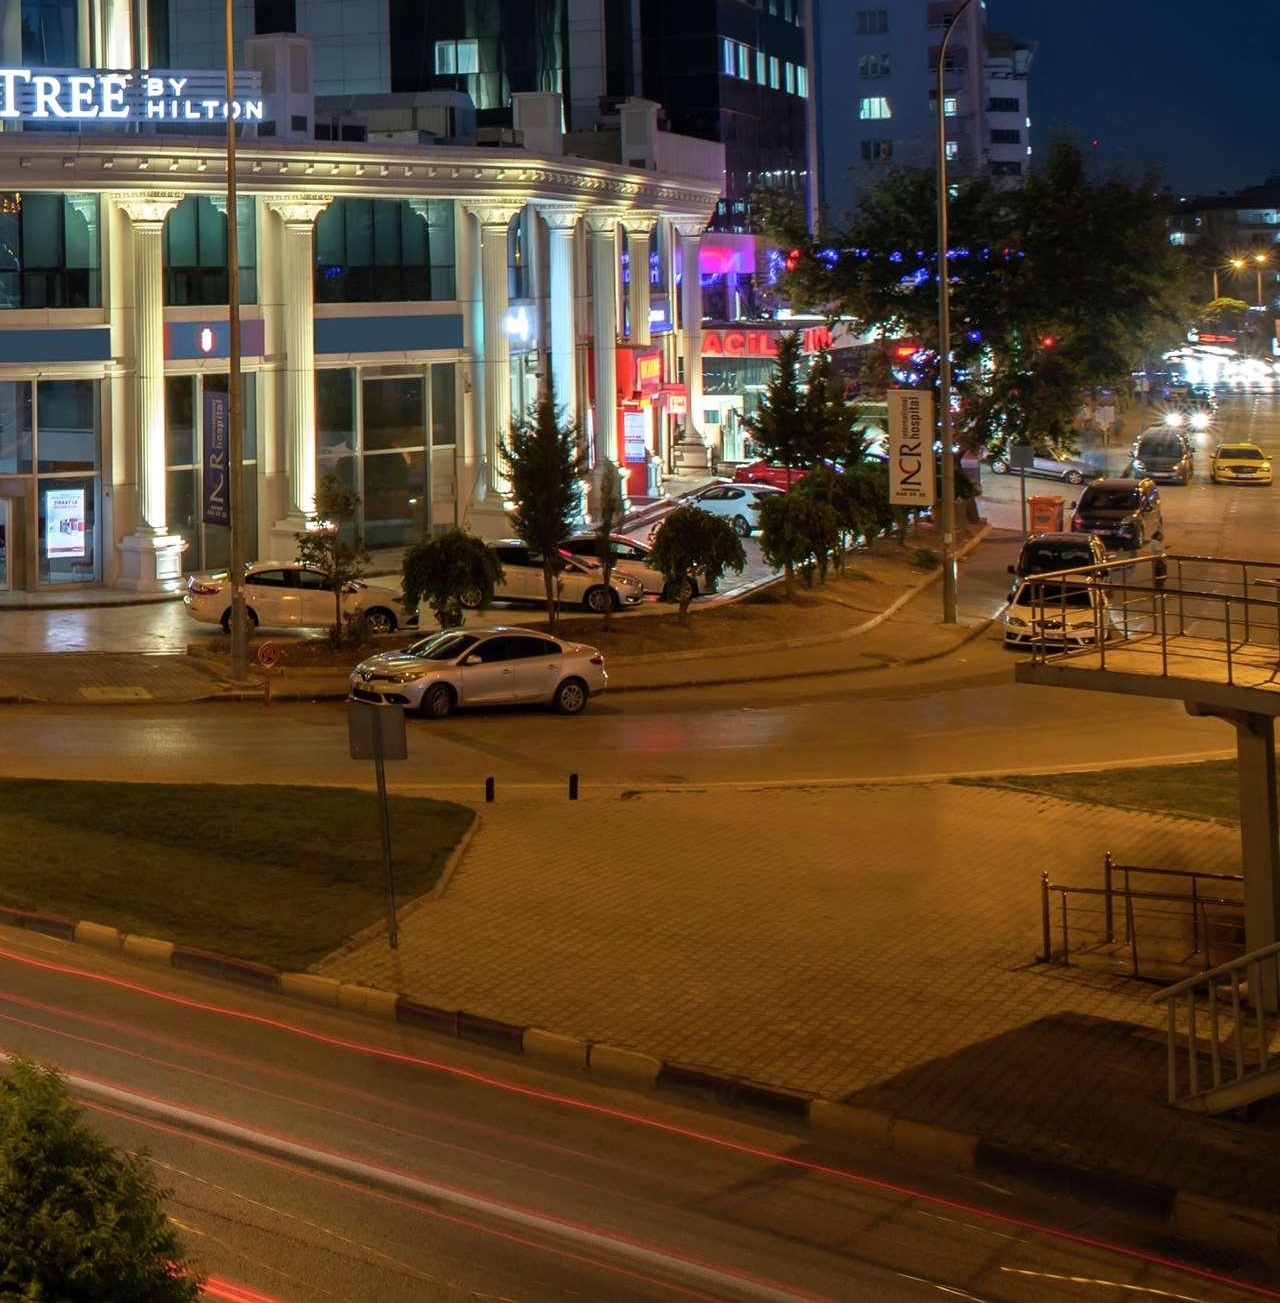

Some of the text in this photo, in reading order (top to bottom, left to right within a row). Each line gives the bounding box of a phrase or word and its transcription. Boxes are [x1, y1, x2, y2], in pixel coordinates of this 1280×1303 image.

[147, 78, 188, 96] BY
[147, 100, 263, 119] HILTON
[215, 399, 225, 449] hospital
[909, 397, 922, 439] hospital
